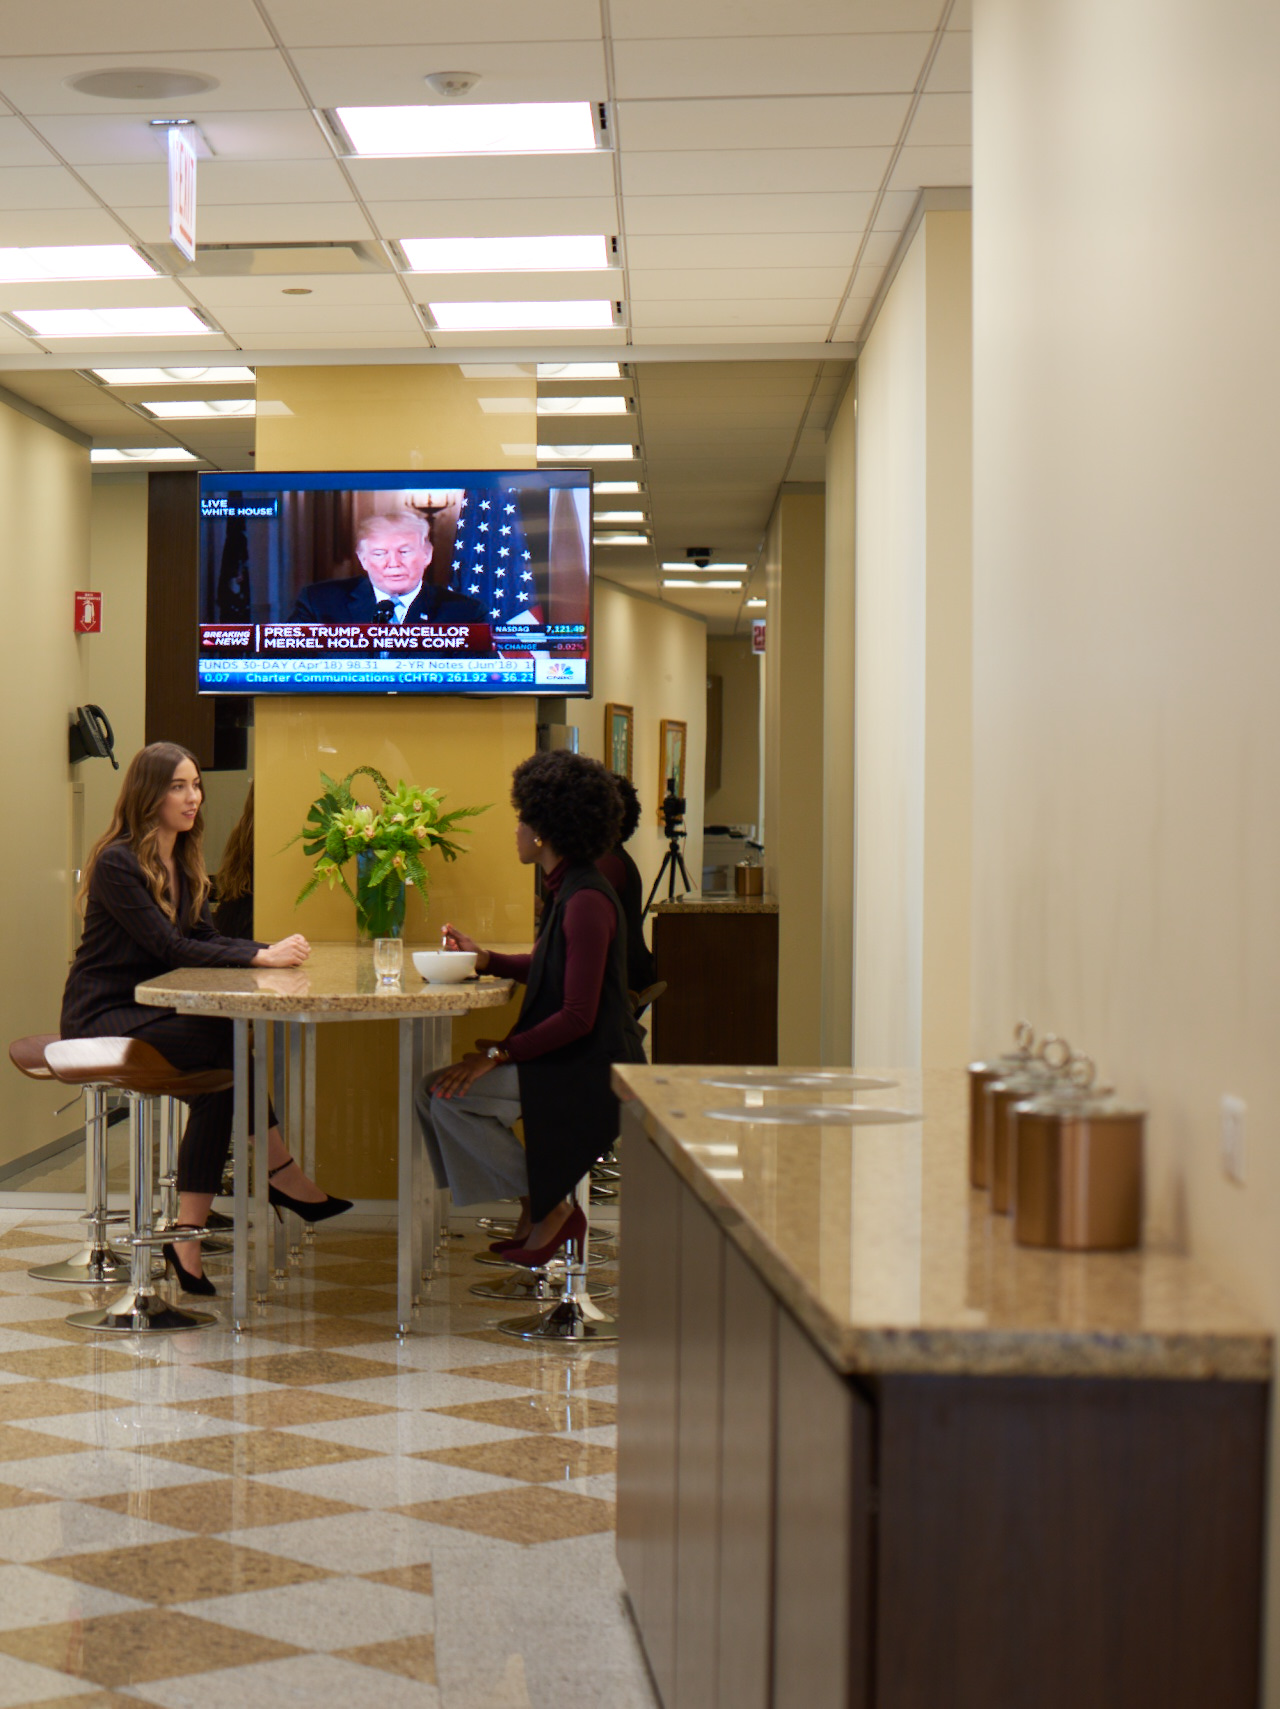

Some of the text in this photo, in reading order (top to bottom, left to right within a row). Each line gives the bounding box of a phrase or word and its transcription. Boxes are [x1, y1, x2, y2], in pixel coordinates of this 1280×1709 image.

[201, 499, 228, 508] LIVE
[202, 508, 273, 516] WHITE HOUSE
[203, 631, 251, 639] BREAKING
[264, 627, 470, 639] PRES. TRUMP, CHANCELLOR
[214, 637, 250, 646] NEWS
[264, 638, 469, 649] MERKEL HOLD NEWS CONF.
[243, 661, 287, 670] 30-DAY
[346, 661, 378, 670] 98.31
[395, 661, 425, 670] 2-YR
[428, 661, 464, 670] Notes
[204, 673, 230, 683] 0.07
[246, 673, 291, 682] Charter
[294, 673, 395, 682] Communications
[399, 672, 444, 684] (CHTR)
[446, 673, 488, 683] 261.92
